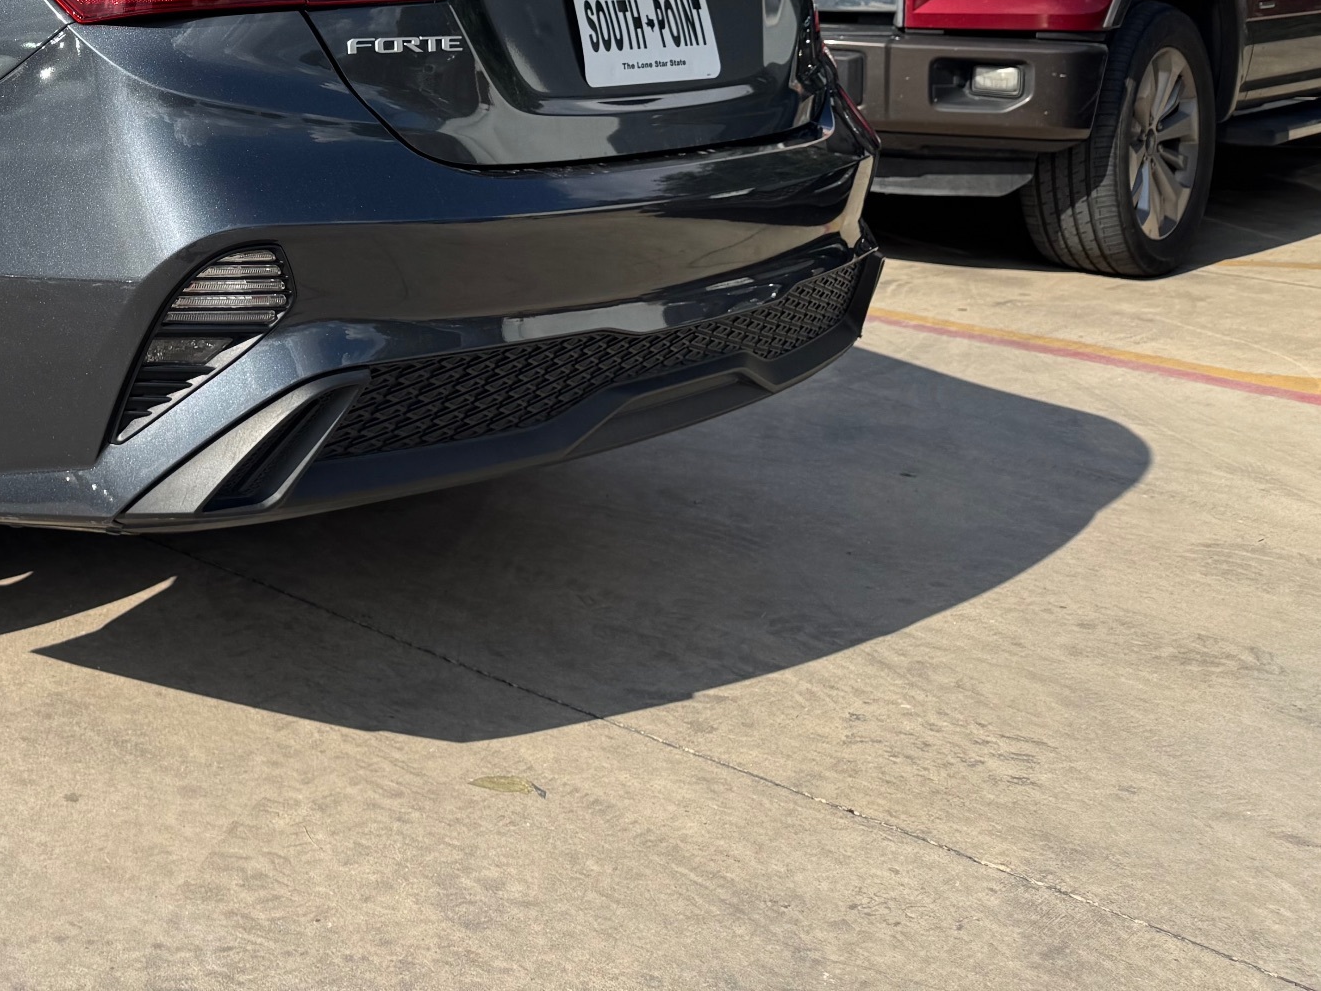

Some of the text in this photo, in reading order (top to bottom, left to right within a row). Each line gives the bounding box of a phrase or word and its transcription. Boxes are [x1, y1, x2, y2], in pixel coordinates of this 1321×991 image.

[583, 0, 648, 53] SOUTH
[347, 36, 463, 55] FORTE
[622, 59, 687, 70] The Lone Star State
